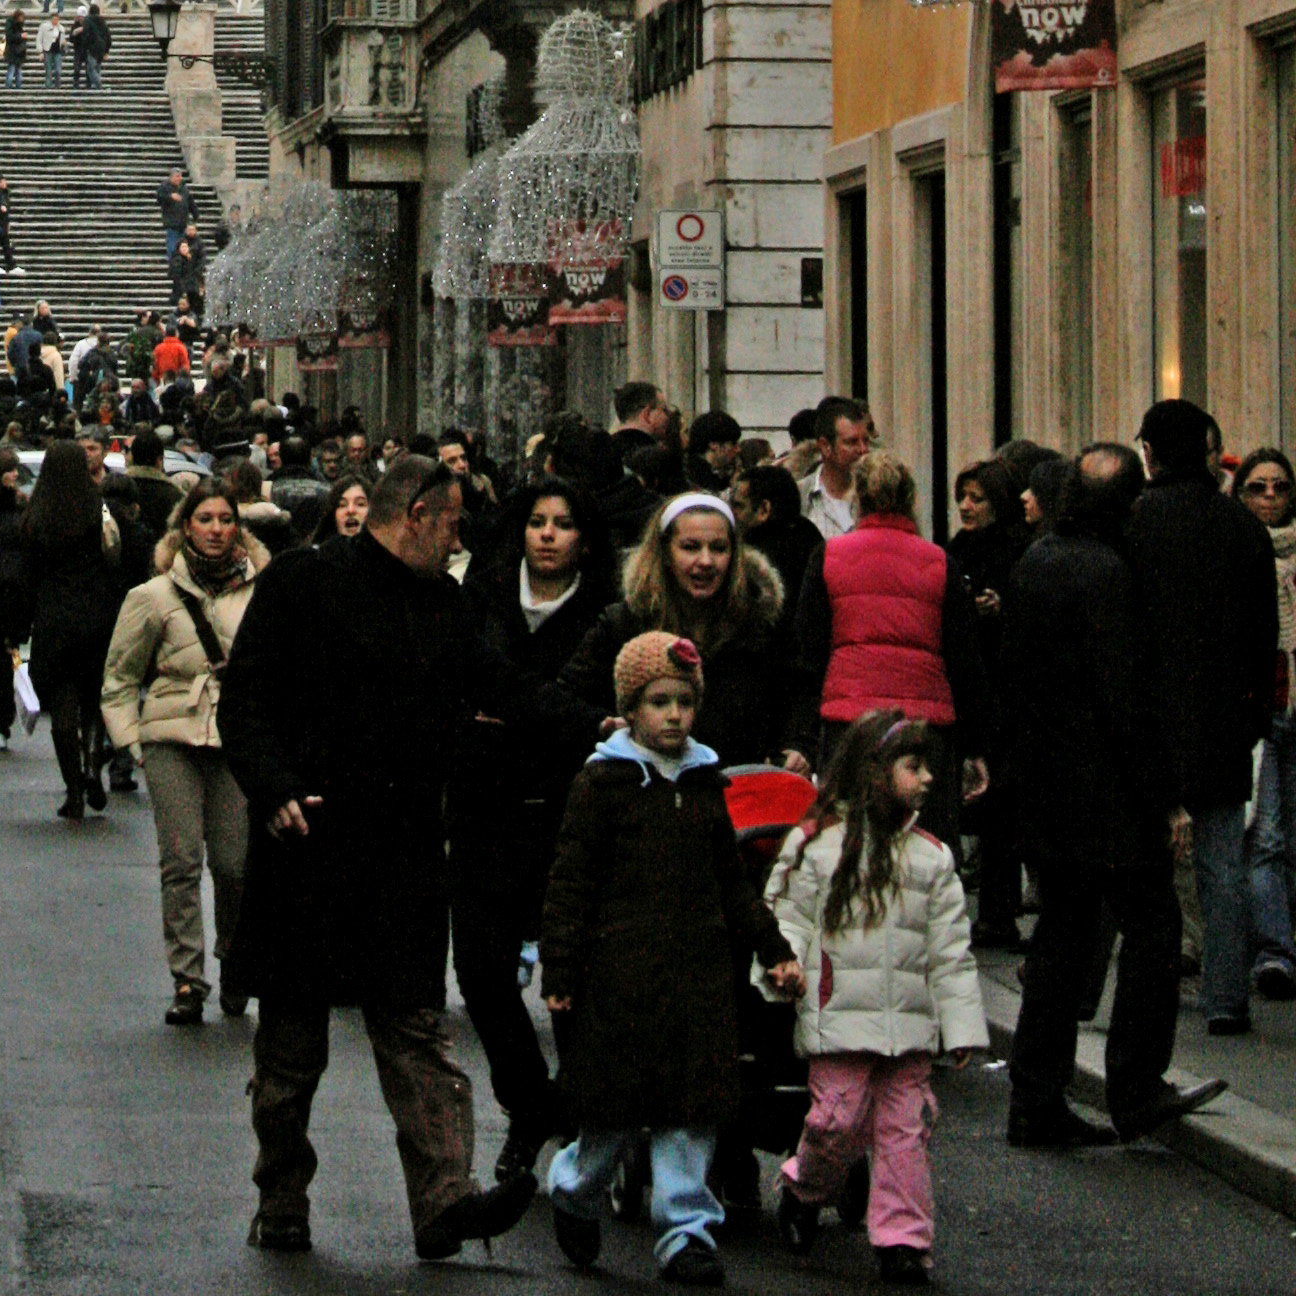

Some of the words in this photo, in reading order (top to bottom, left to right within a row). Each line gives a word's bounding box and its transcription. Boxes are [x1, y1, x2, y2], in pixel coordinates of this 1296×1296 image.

[1019, 6, 1087, 30] now
[565, 272, 606, 287] now
[503, 299, 540, 313] now
